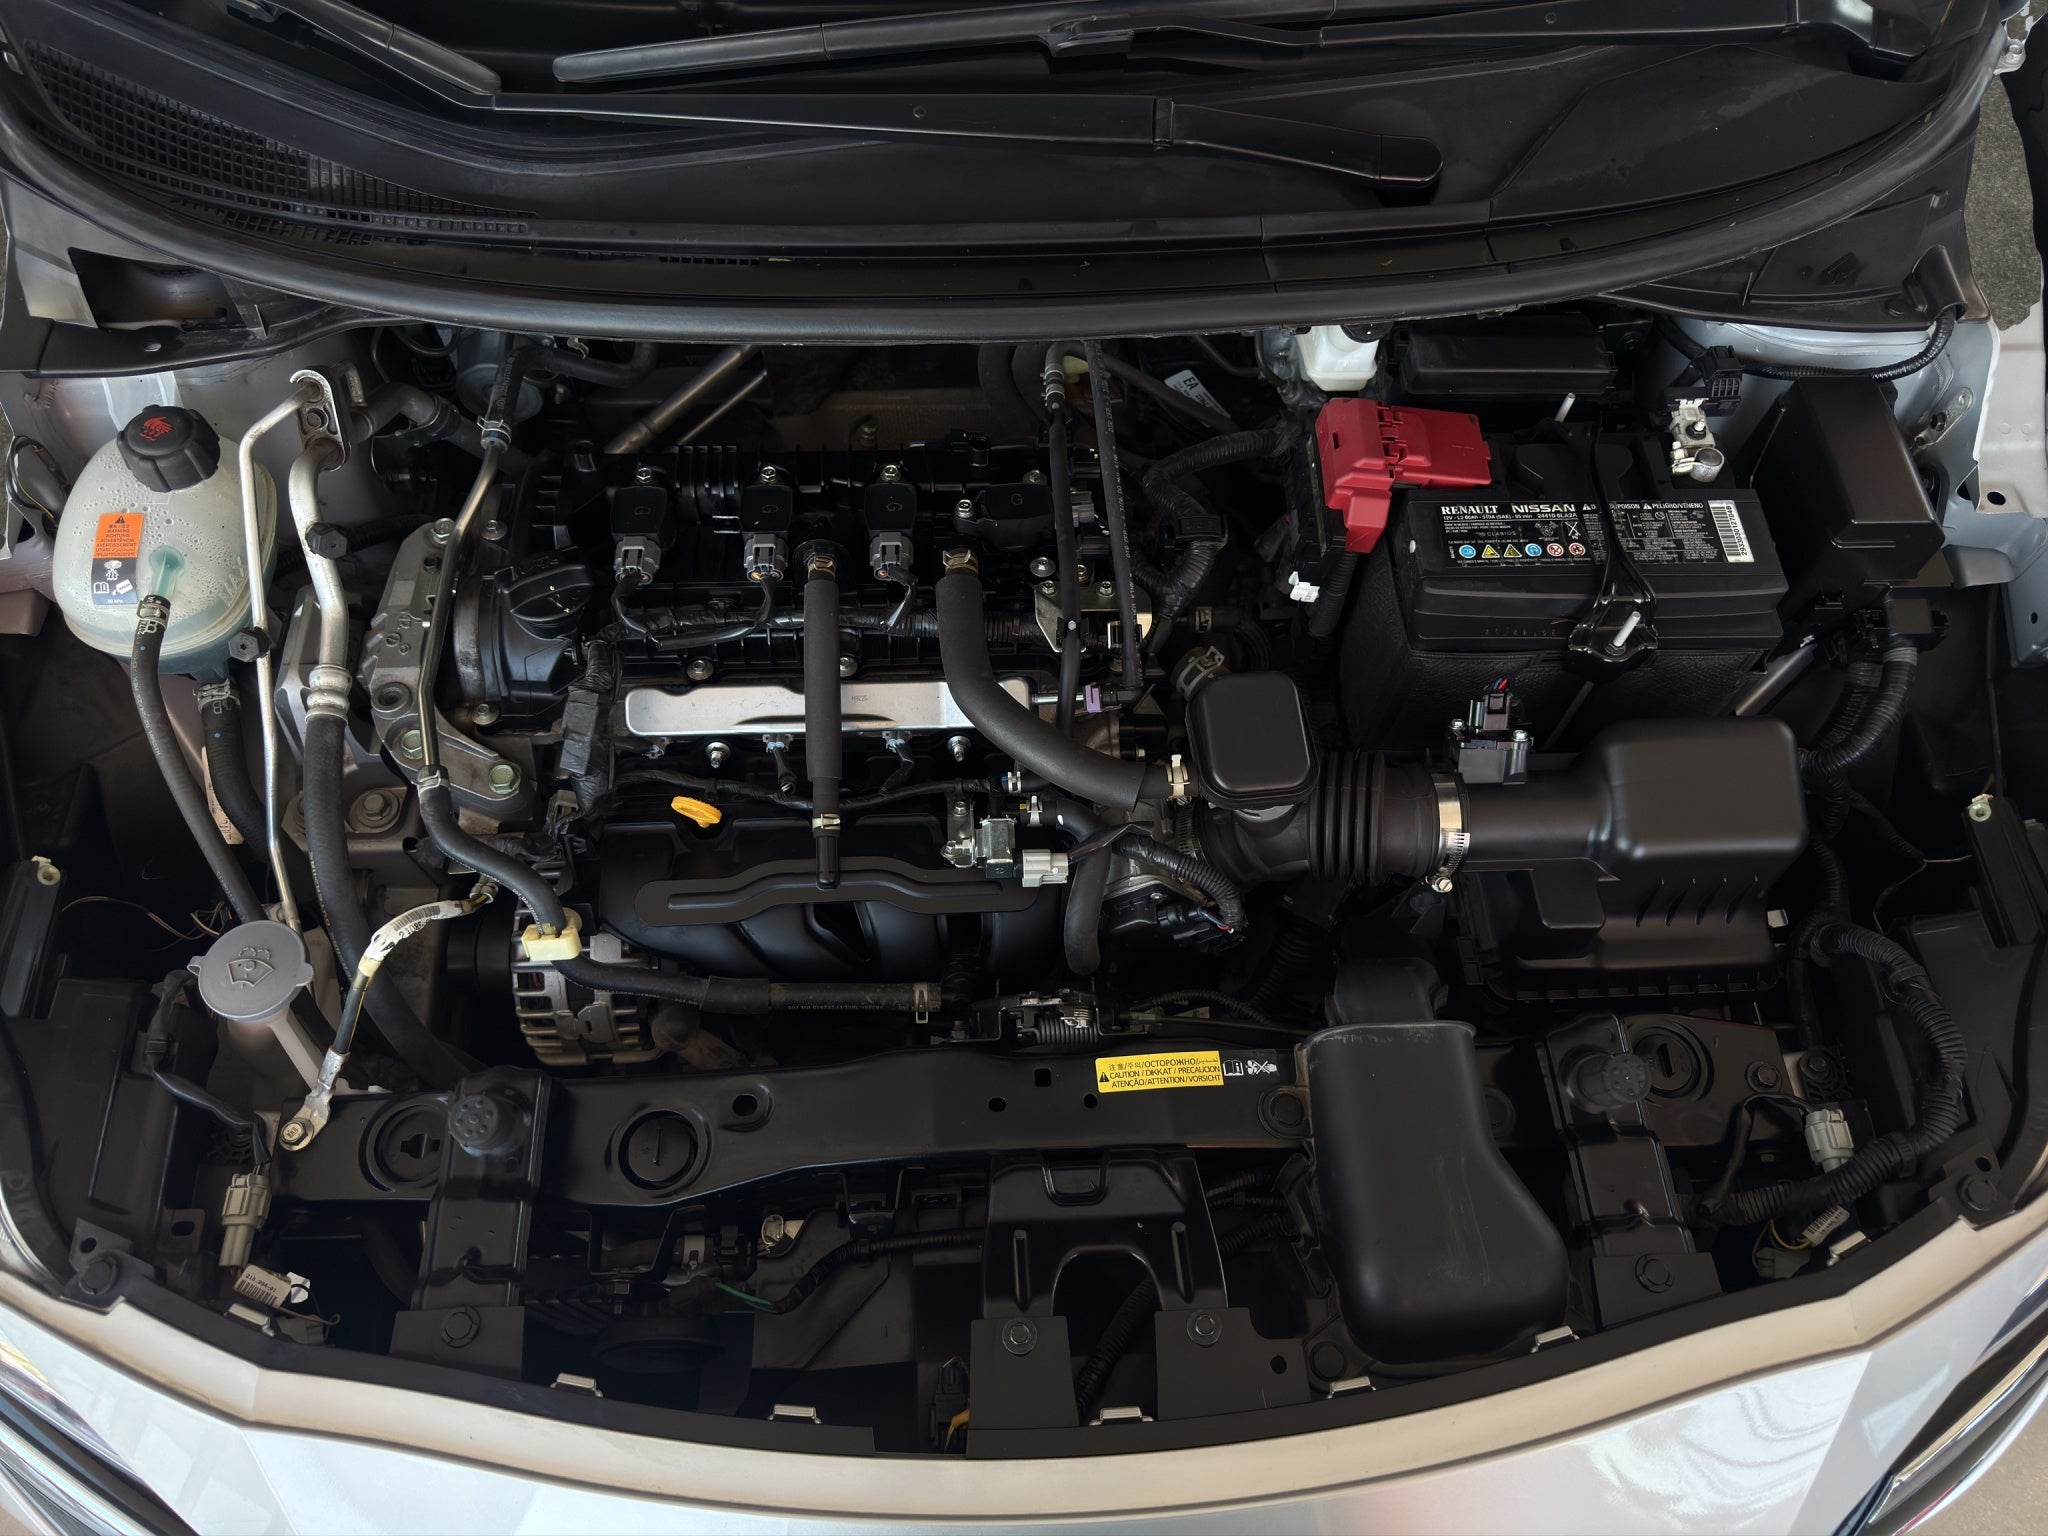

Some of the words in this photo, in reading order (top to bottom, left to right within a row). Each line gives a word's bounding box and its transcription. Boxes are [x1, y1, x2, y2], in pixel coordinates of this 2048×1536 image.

[1440, 505, 1498, 514] RENAULT
[1512, 503, 1575, 513] NISSAN
[1109, 1070, 1140, 1080] CAUTION
[1145, 1067, 1172, 1077] DIKKAT
